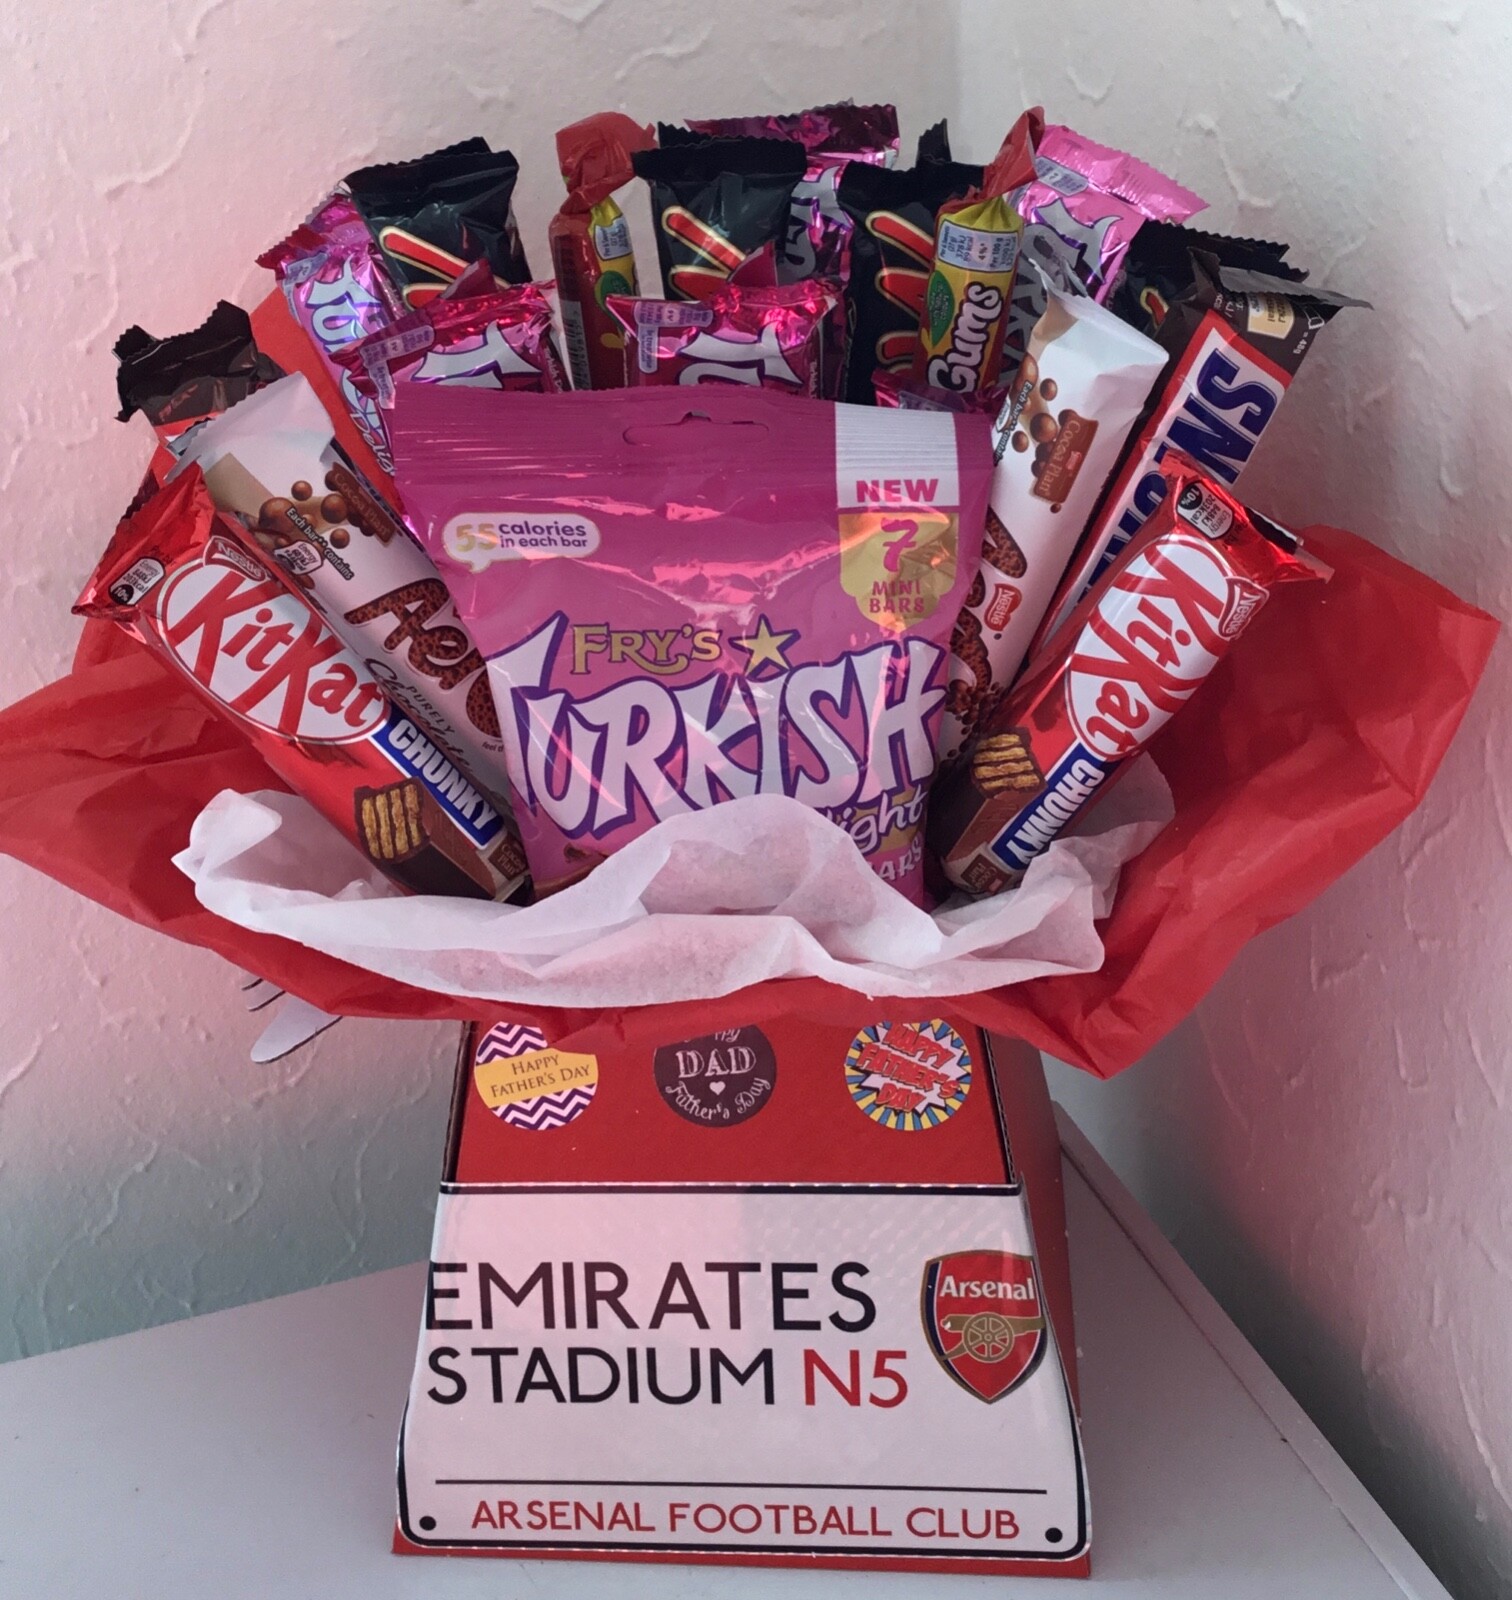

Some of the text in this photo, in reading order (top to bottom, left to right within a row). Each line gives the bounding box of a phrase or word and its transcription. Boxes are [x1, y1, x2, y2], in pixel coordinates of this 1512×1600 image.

[928, 281, 1003, 394] Gums
[1020, 381, 1033, 404] Each
[350, 411, 395, 476] Delig
[1054, 421, 1080, 461] Cocoa
[856, 479, 939, 503] NEW
[1181, 488, 1200, 506] 10%
[1190, 494, 1216, 525] 203kcal
[499, 520, 587, 537] calories
[1201, 502, 1222, 527] 848kJ
[286, 508, 306, 529] Each
[324, 547, 353, 580] contains
[456, 523, 498, 552] 55
[500, 536, 588, 548] in each bar
[880, 517, 919, 573] 7
[869, 598, 925, 613] BARS
[872, 581, 921, 596] MINI
[164, 575, 386, 736] KitKat
[572, 624, 722, 676] FRY'S
[1069, 544, 1234, 754] KitKat
[406, 685, 456, 734] PURELY
[388, 717, 496, 831] CHUNKY
[1006, 756, 1105, 871] CHUNKY
[874, 832, 922, 881] ARS
[511, 1054, 560, 1076] HAPPY
[675, 1046, 757, 1078] DAD
[881, 1021, 956, 1070] HAPPY
[490, 1064, 590, 1098] FATHER'S DAY
[855, 1041, 960, 1098] FATHER'S
[665, 1077, 771, 1120] Father's Day
[875, 1082, 927, 1114] DAY
[426, 1259, 878, 1332] EMIRATES
[939, 1274, 1036, 1303] Arsenal
[426, 1345, 910, 1409] STADIUM N5
[470, 1499, 1021, 1541] ARSENAL FOOTBALL CLUB
